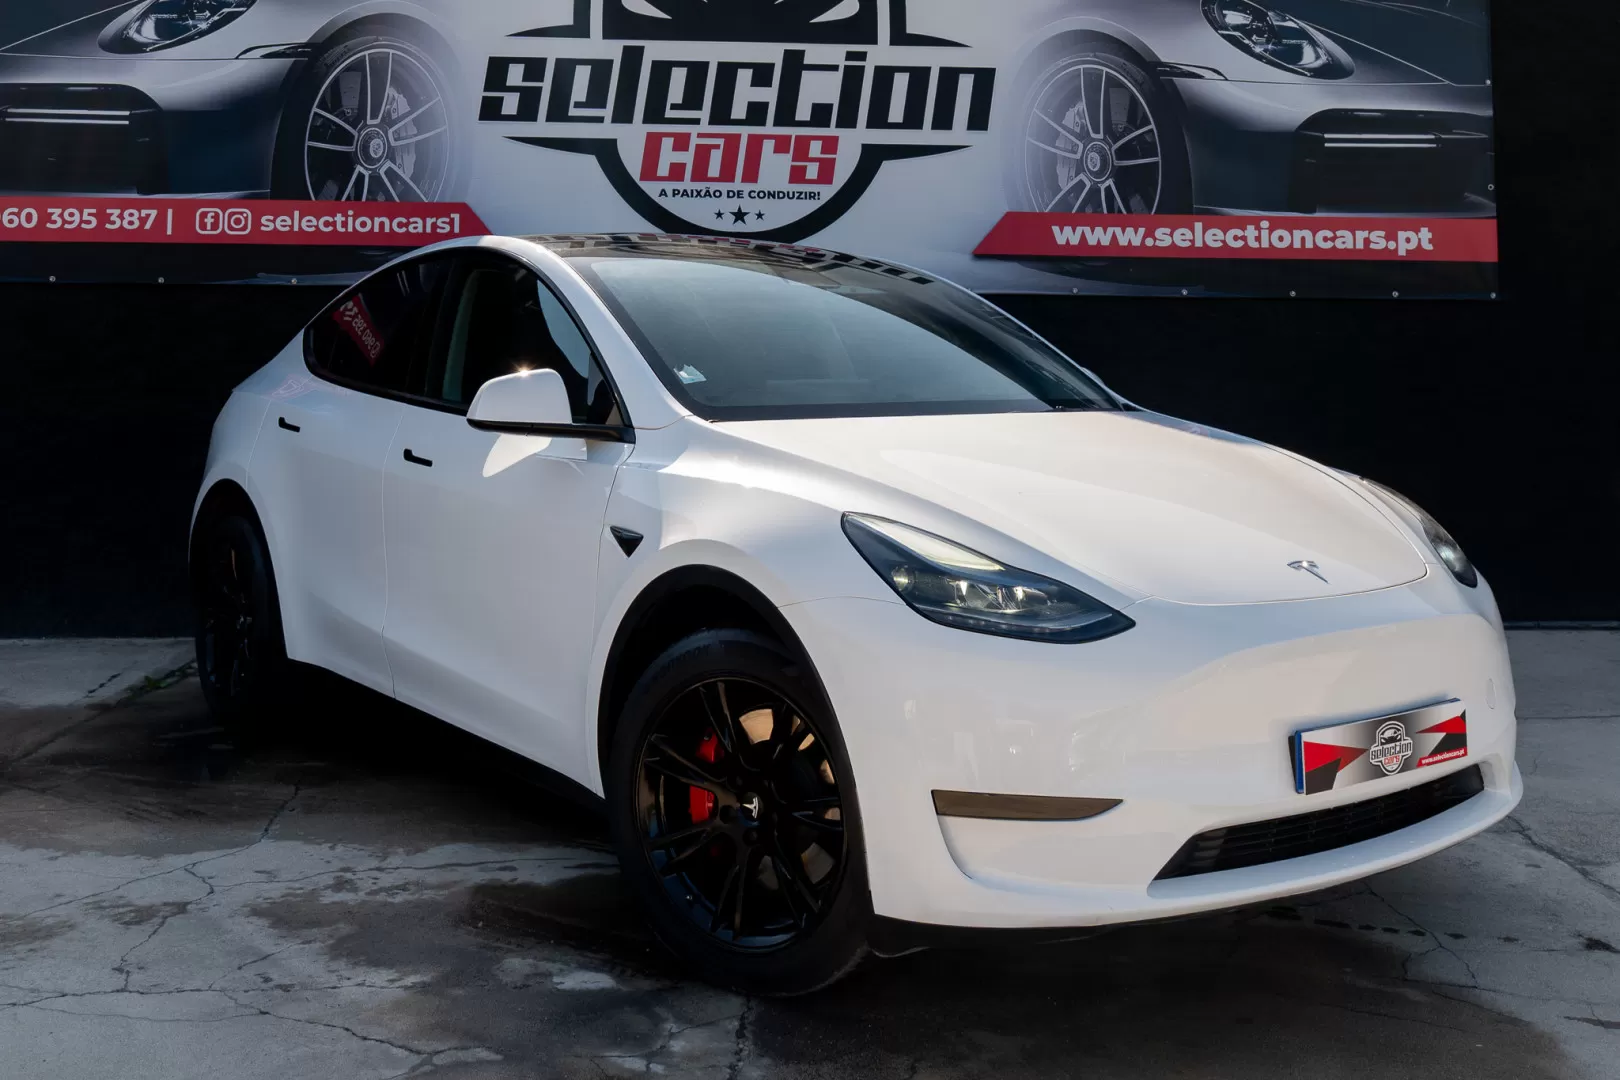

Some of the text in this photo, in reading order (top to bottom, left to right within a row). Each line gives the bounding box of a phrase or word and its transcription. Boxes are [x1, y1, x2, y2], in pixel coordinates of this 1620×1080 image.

[478, 45, 996, 131] selection
[640, 132, 839, 185] cars
[658, 186, 821, 201] A PAIXÃO DE CONDUZIR!
[0, 207, 39, 229] 60
[46, 208, 97, 230] 395
[104, 208, 158, 231] 387
[260, 210, 460, 234] selectioncars1
[1051, 219, 1434, 257] www.selectioncars.pt
[1371, 742, 1412, 760] selection
[1383, 755, 1400, 766] cars
